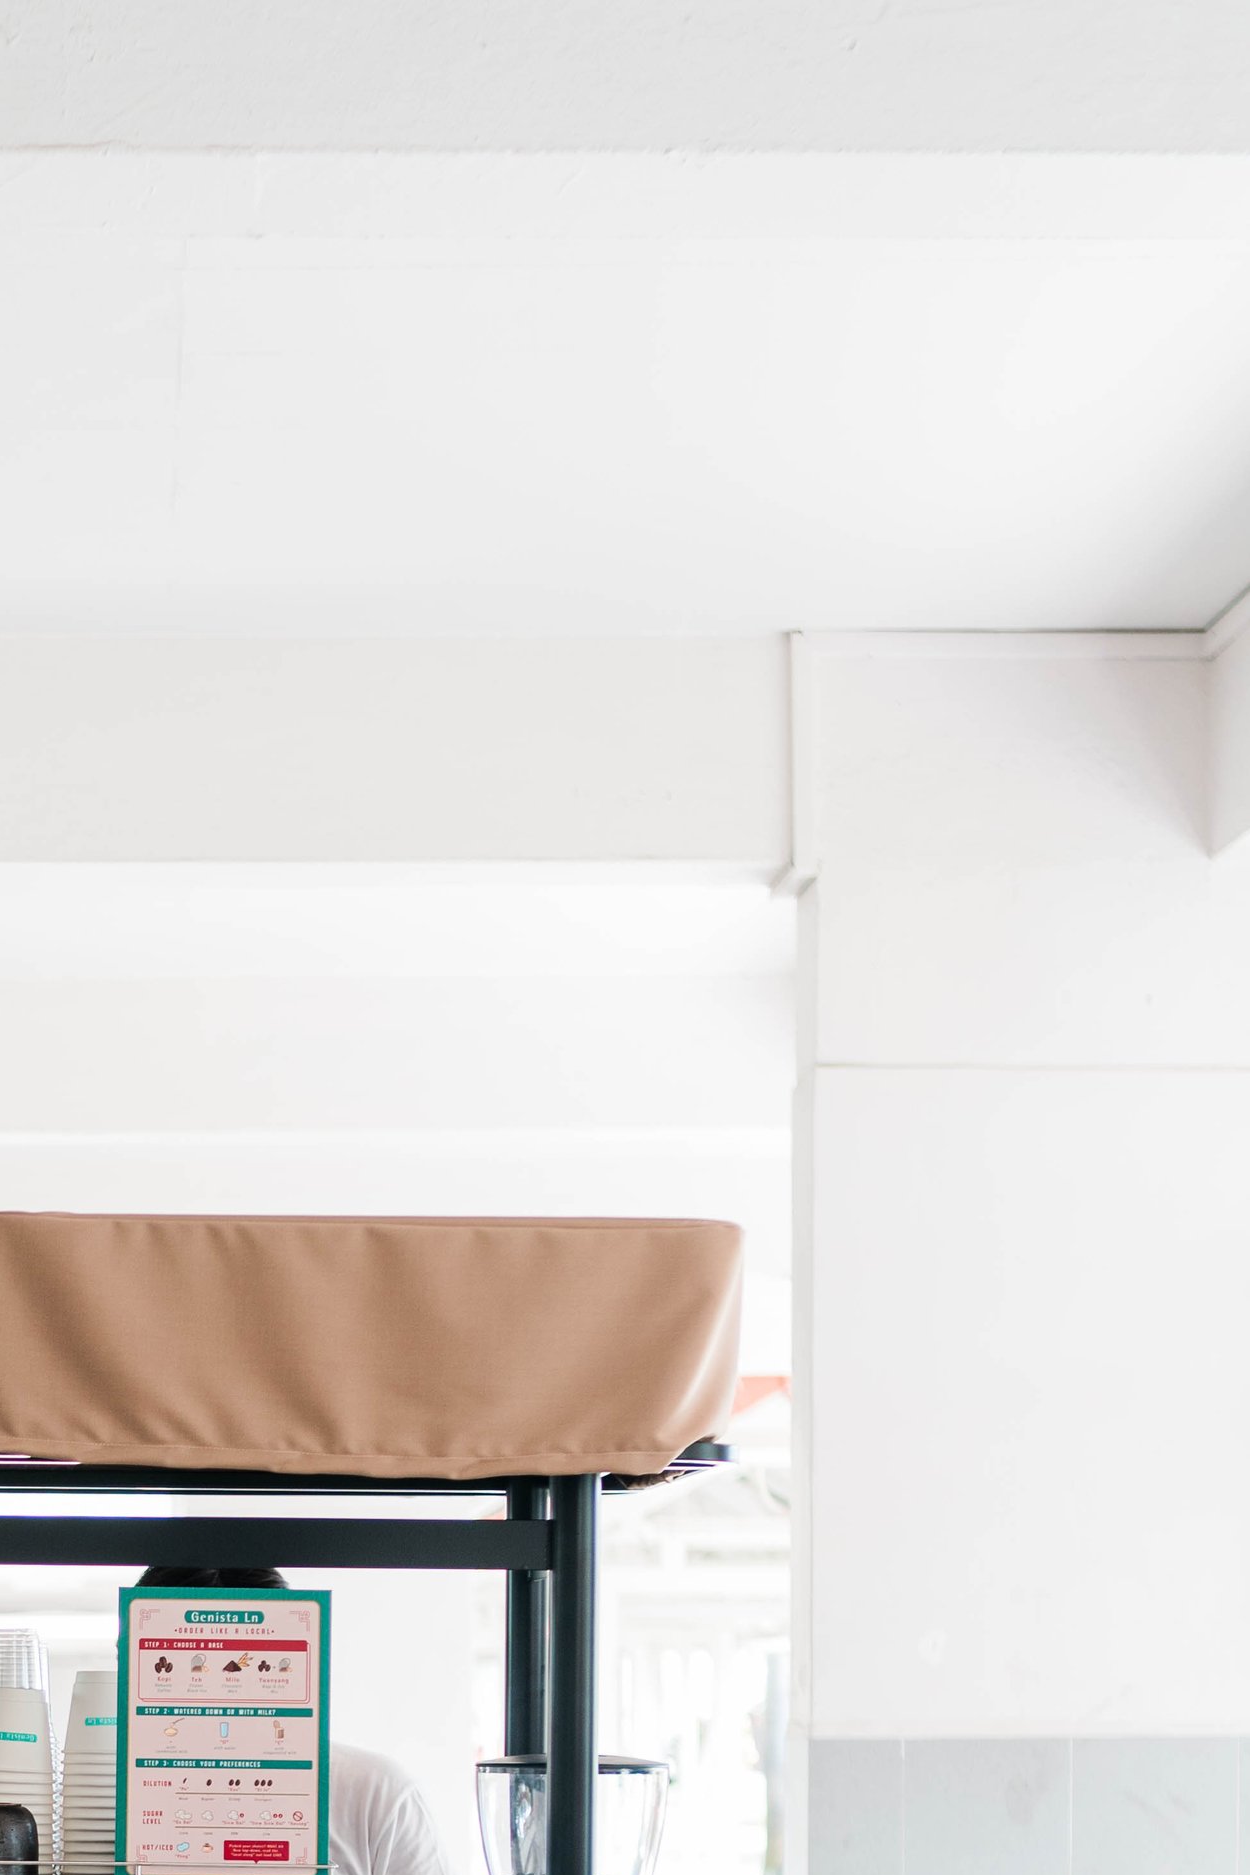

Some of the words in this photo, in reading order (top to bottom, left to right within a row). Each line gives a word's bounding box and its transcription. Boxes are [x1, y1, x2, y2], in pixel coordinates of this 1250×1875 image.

[191, 1611, 239, 1623] Genista
[244, 1612, 259, 1623] Ln
[210, 1627, 229, 1635] LIKE
[246, 1627, 271, 1636] LOCAL
[144, 1641, 160, 1649] STEP
[173, 1641, 197, 1649] CHOOSE
[144, 1707, 160, 1715] STEP
[144, 1759, 160, 1767] STEP
[172, 1760, 197, 1768] CHOOSE
